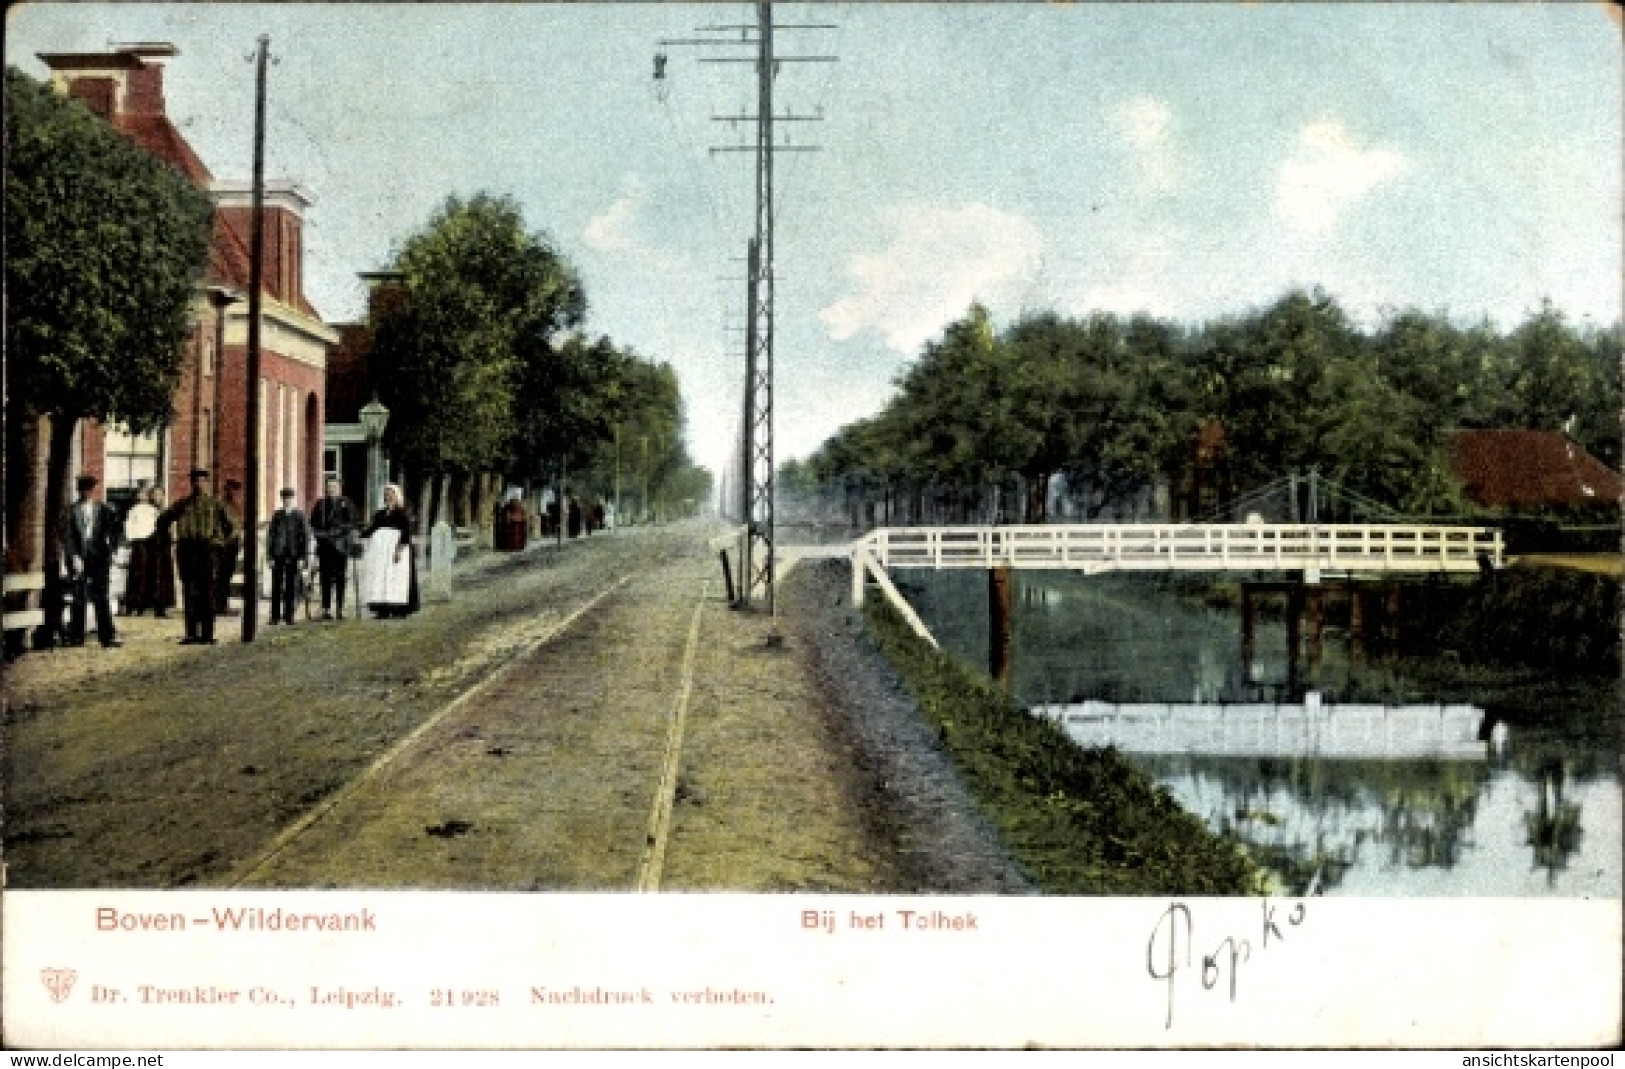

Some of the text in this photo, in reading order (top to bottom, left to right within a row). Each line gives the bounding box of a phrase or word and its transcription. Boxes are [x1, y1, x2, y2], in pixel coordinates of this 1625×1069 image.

[800, 909, 979, 934] Bij het Tolhek
[91, 985, 127, 1004] Dr.
[136, 985, 241, 1005] Trenkler
[309, 985, 403, 1009] Leipzig.
[529, 985, 654, 1005] Nachdruck
[671, 985, 775, 1005] verboten.
